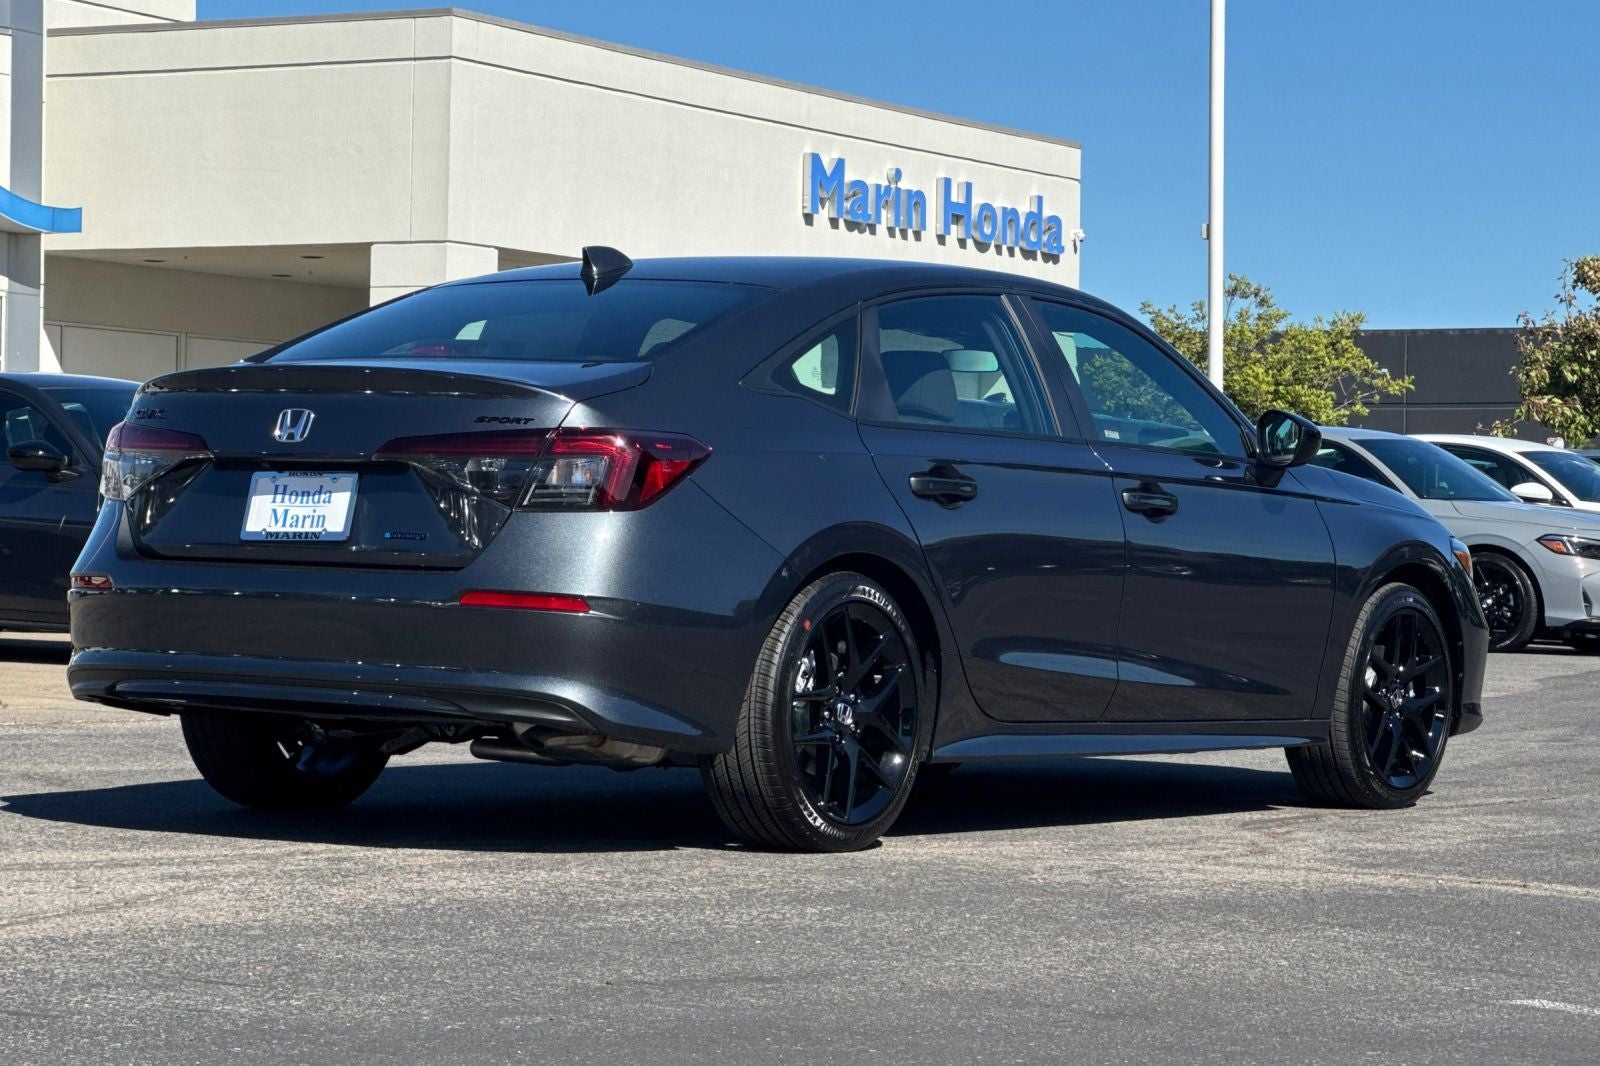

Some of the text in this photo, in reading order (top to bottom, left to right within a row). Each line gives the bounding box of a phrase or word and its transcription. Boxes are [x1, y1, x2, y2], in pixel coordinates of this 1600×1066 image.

[803, 152, 1064, 254] Marin Honda
[473, 416, 536, 424] SPORT
[270, 484, 332, 505] Honda
[268, 508, 326, 528] Marin
[265, 532, 320, 540] MARIN
